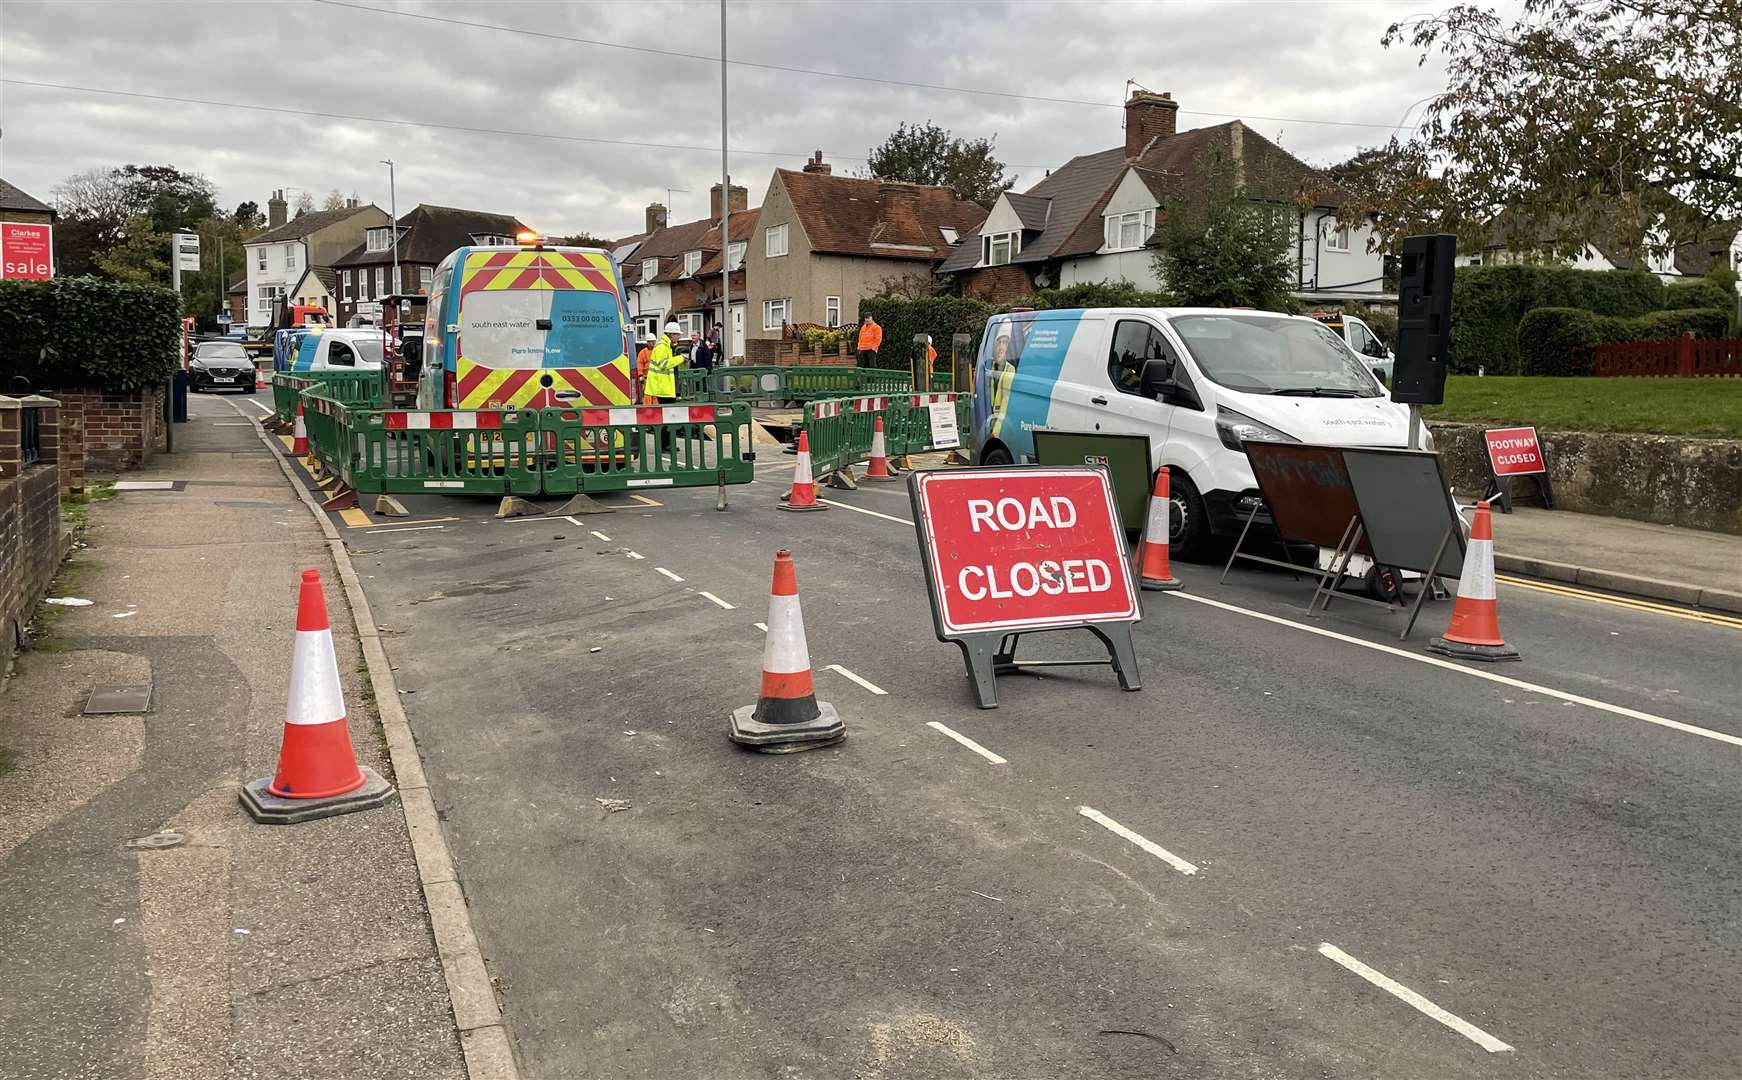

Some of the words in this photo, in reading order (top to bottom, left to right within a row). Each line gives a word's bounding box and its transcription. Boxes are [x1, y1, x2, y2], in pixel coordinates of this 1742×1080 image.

[6, 258, 48, 274] sale
[472, 320, 492, 328] south
[1490, 437, 1535, 450] FOOTWAY
[1497, 453, 1536, 465] CLOSED
[968, 496, 1077, 532] ROAD
[959, 559, 1112, 601] CLOSED
